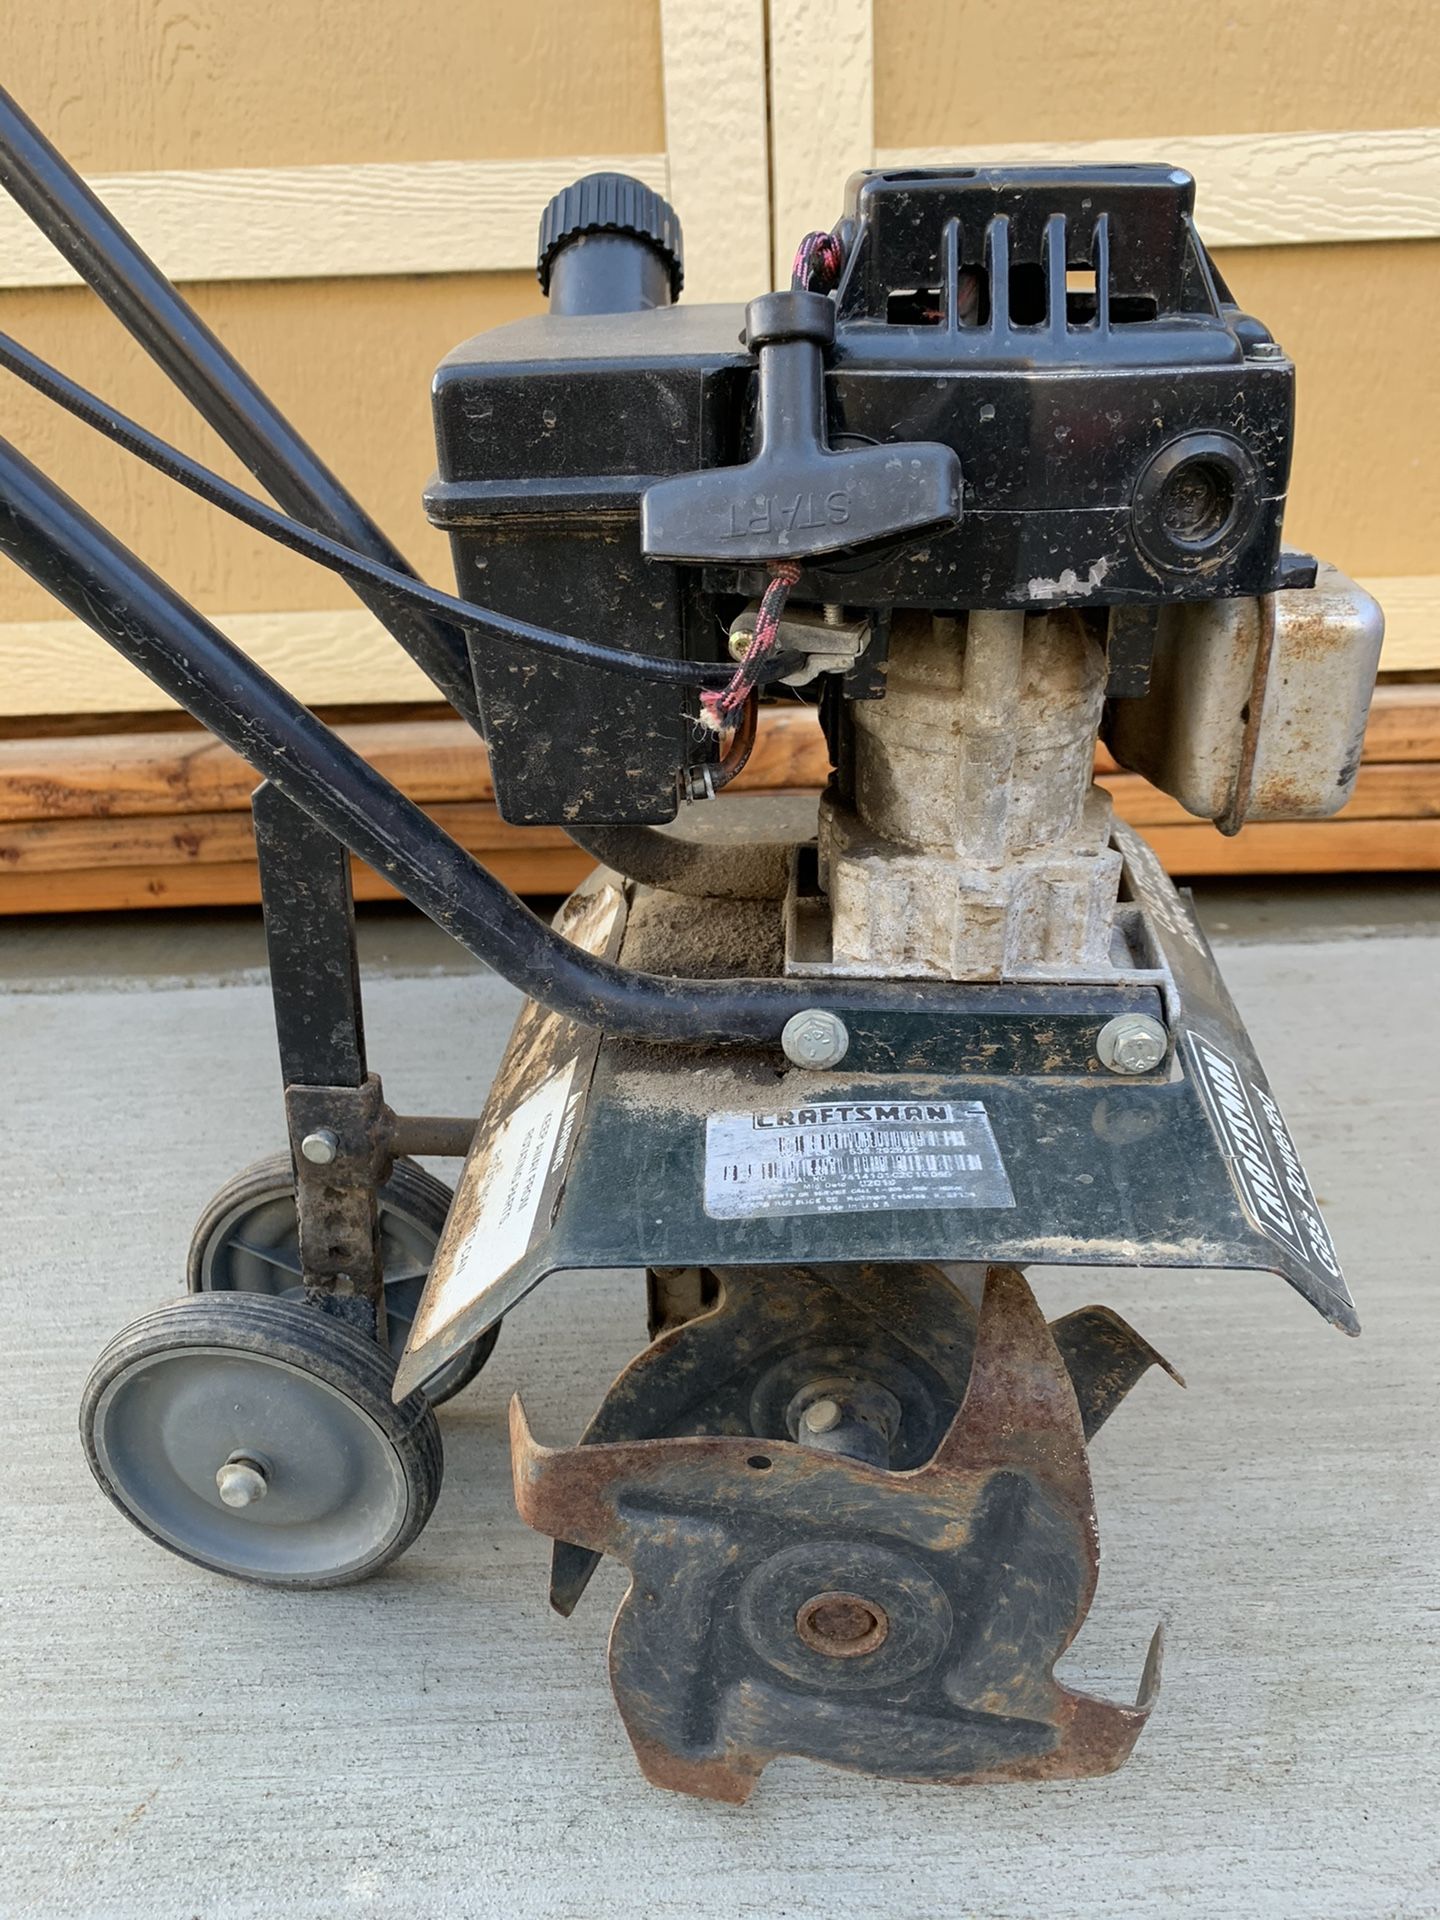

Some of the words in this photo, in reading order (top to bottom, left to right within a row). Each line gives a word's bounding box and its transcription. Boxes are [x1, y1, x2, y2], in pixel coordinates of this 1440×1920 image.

[720, 490, 851, 539] START
[551, 1107, 577, 1174] WARNING
[757, 1105, 947, 1128] CRAFTSMAN
[1200, 1046, 1294, 1236] CRAFTSMAN
[1250, 1081, 1314, 1211] Powered
[1302, 1209, 1339, 1278] Gas
